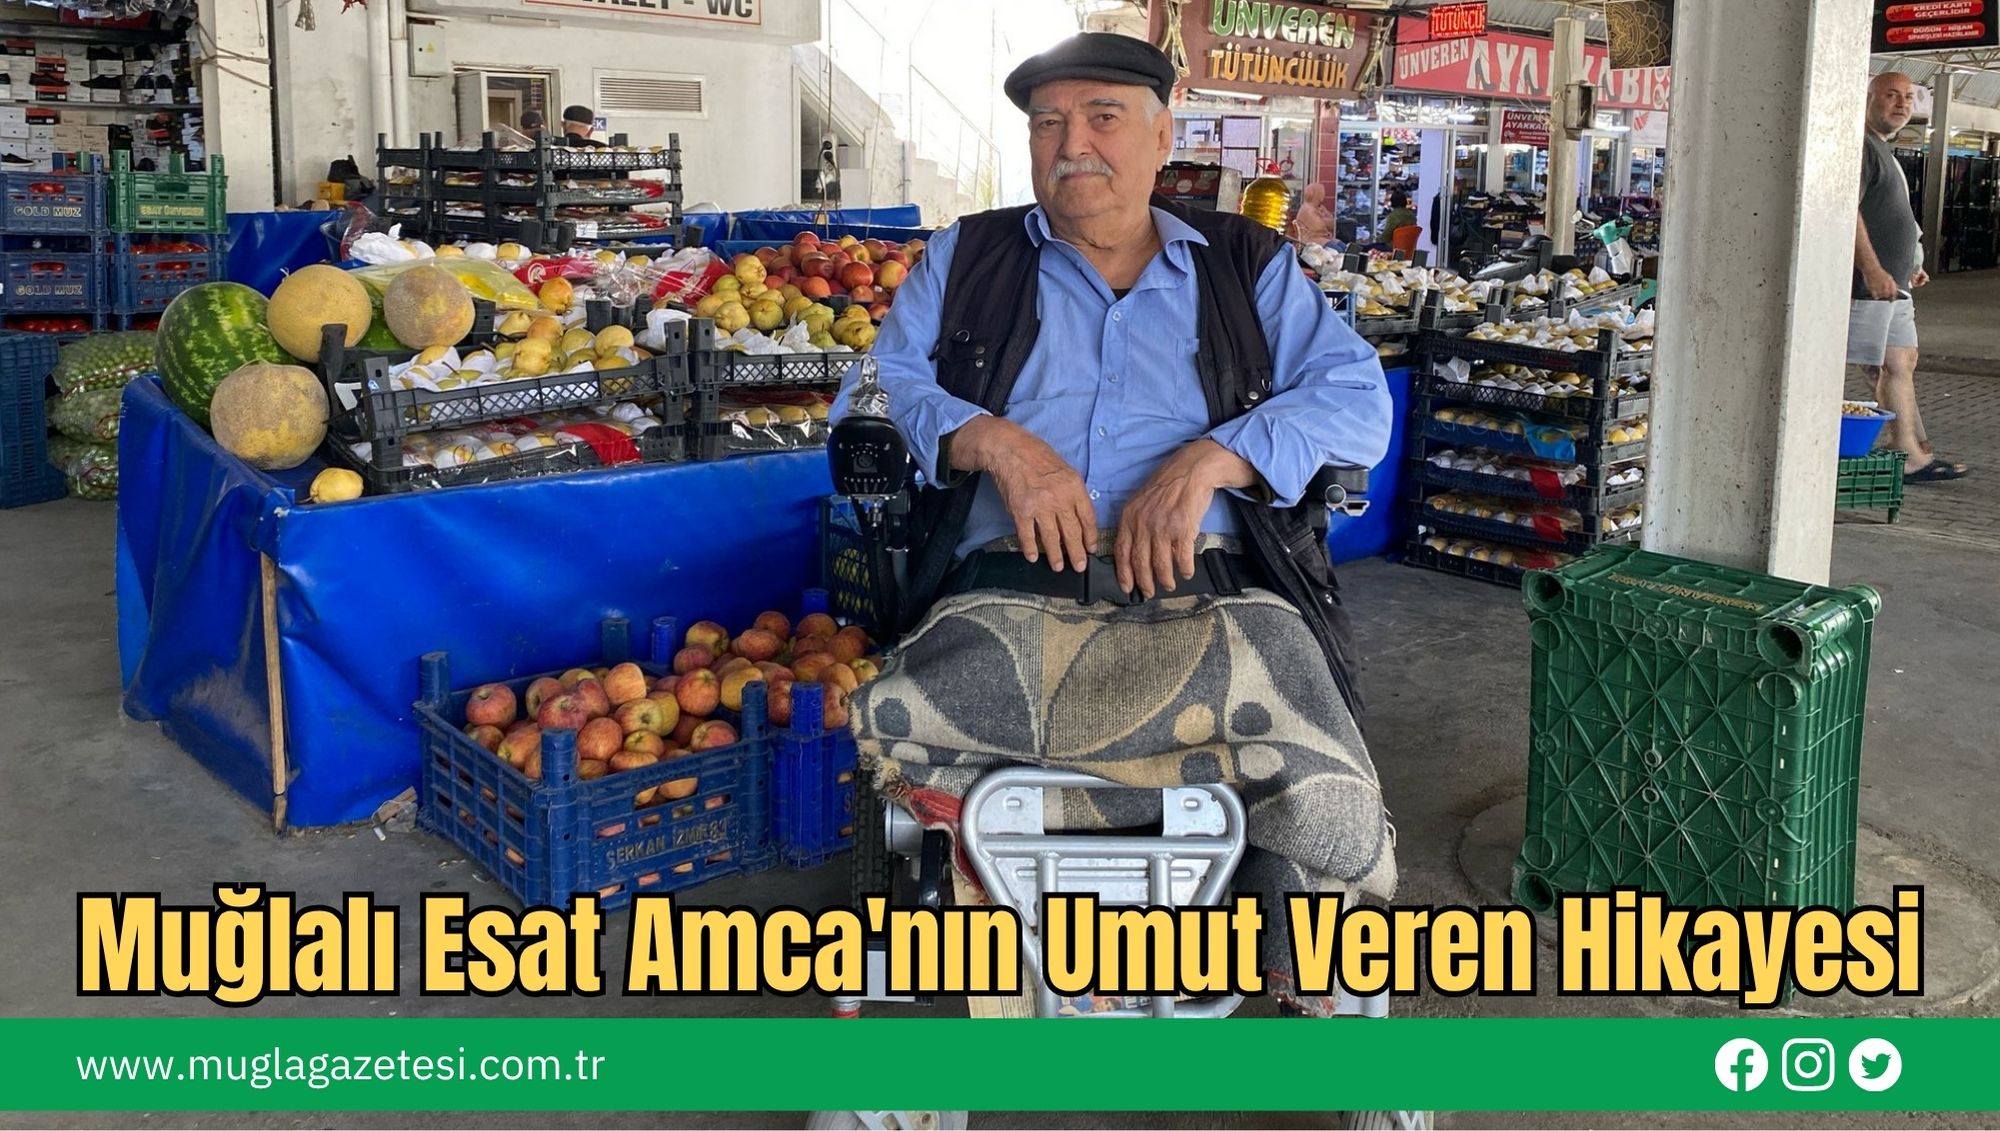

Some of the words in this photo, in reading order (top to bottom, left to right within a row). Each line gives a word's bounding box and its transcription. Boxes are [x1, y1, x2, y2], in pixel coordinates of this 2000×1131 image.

[1913, 2, 1941, 12] KREDİ
[1943, 0, 1972, 9] KARTI
[1915, 7, 1971, 18] GEÇERLİDİR
[1210, 42, 1350, 89] TÜTÜNCÜLÜK
[1399, 38, 1469, 80] ÜNVEREN
[1466, 39, 1652, 105] AYAABI
[14, 206, 50, 217] GOLD
[53, 206, 82, 218] MUZ
[15, 285, 51, 296] GOLD
[54, 285, 83, 296] MUZ
